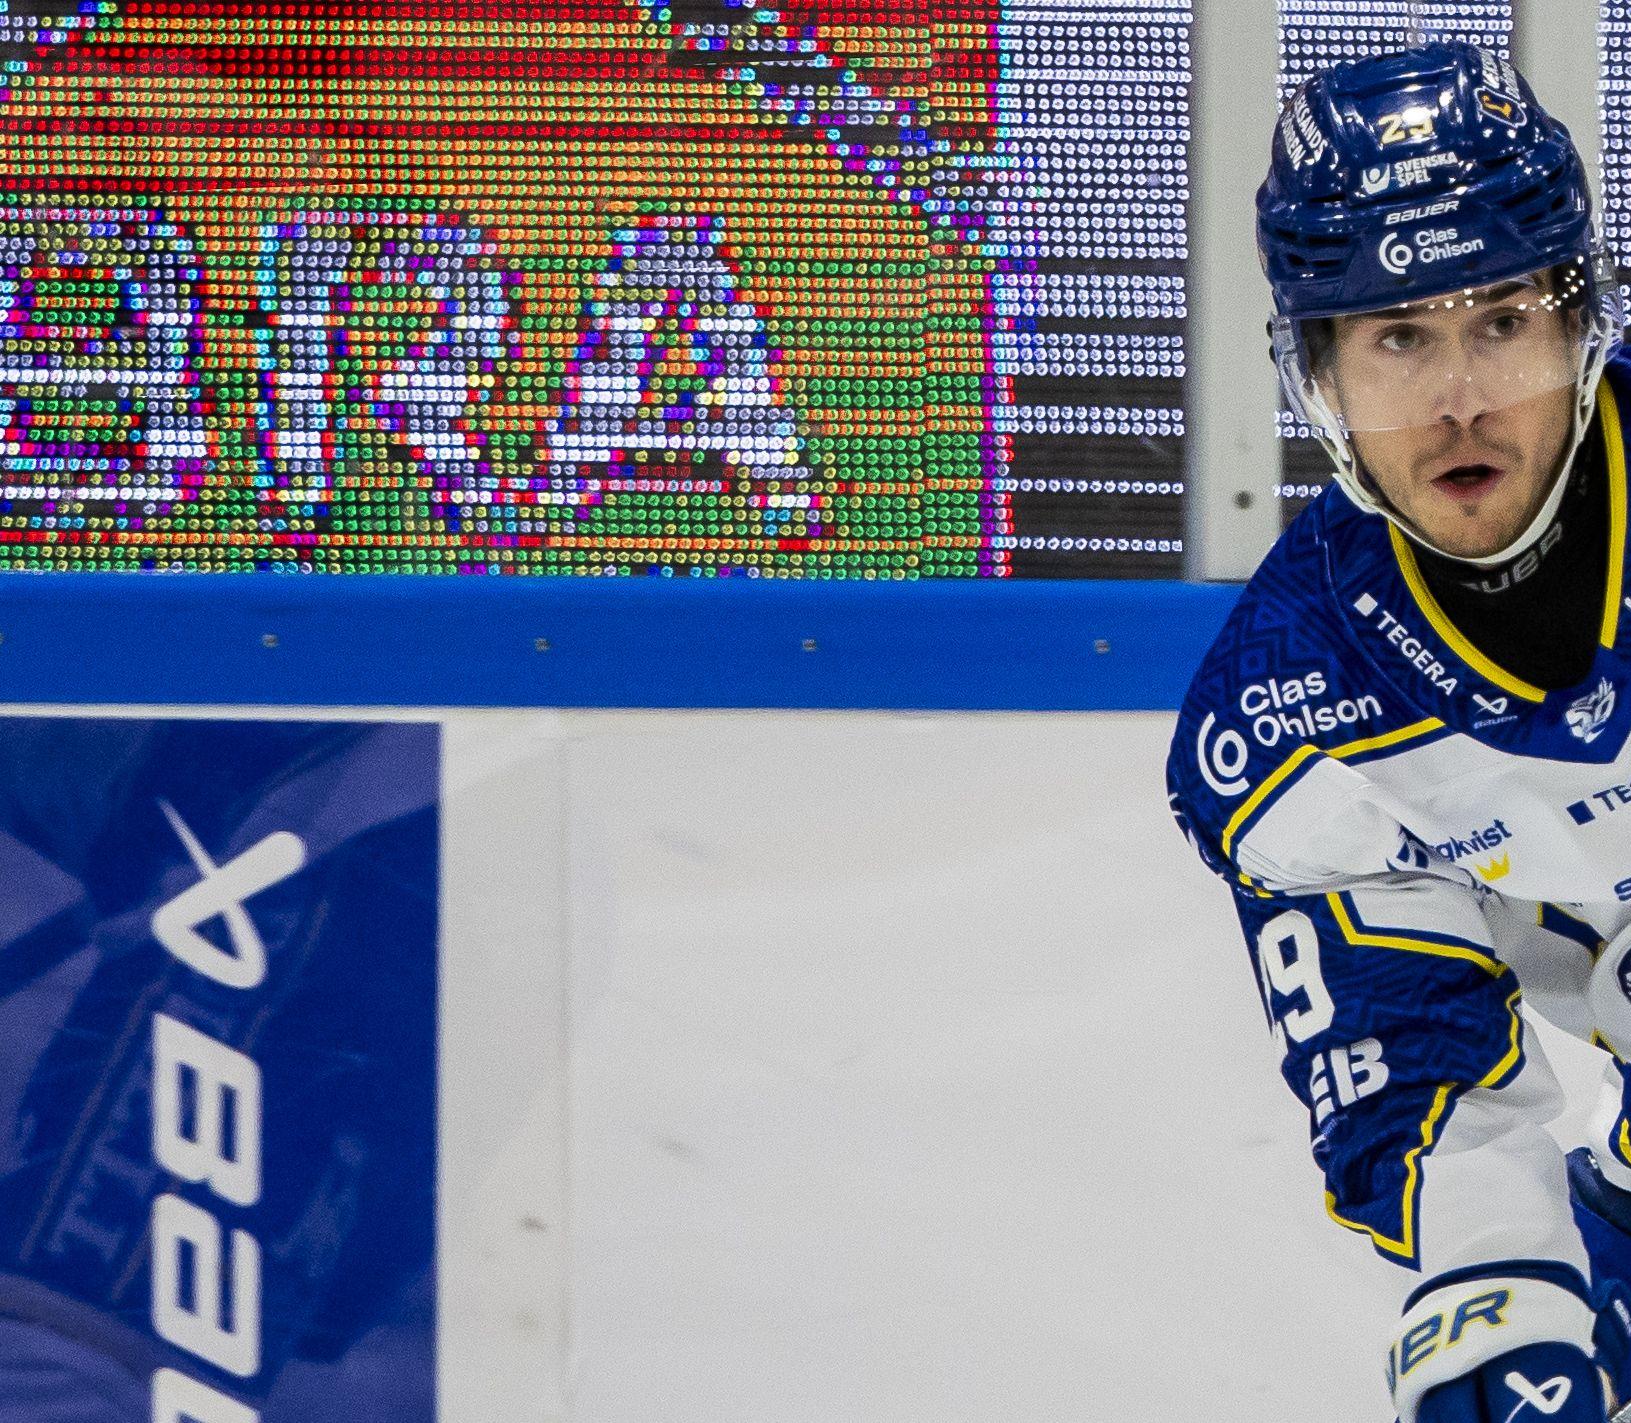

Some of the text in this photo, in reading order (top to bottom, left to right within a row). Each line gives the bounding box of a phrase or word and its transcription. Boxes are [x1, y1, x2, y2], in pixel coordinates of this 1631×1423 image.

[1394, 151, 1458, 174] SVENSKA
[1398, 168, 1431, 188] SPEL
[1415, 228, 1458, 247] Clas
[1419, 238, 1484, 263] Ohlson
[1377, 610, 1458, 697] TEGERA
[1240, 670, 1327, 717] Clas
[1253, 692, 1383, 748] Ohlson
[1256, 909, 1335, 1044] 9
